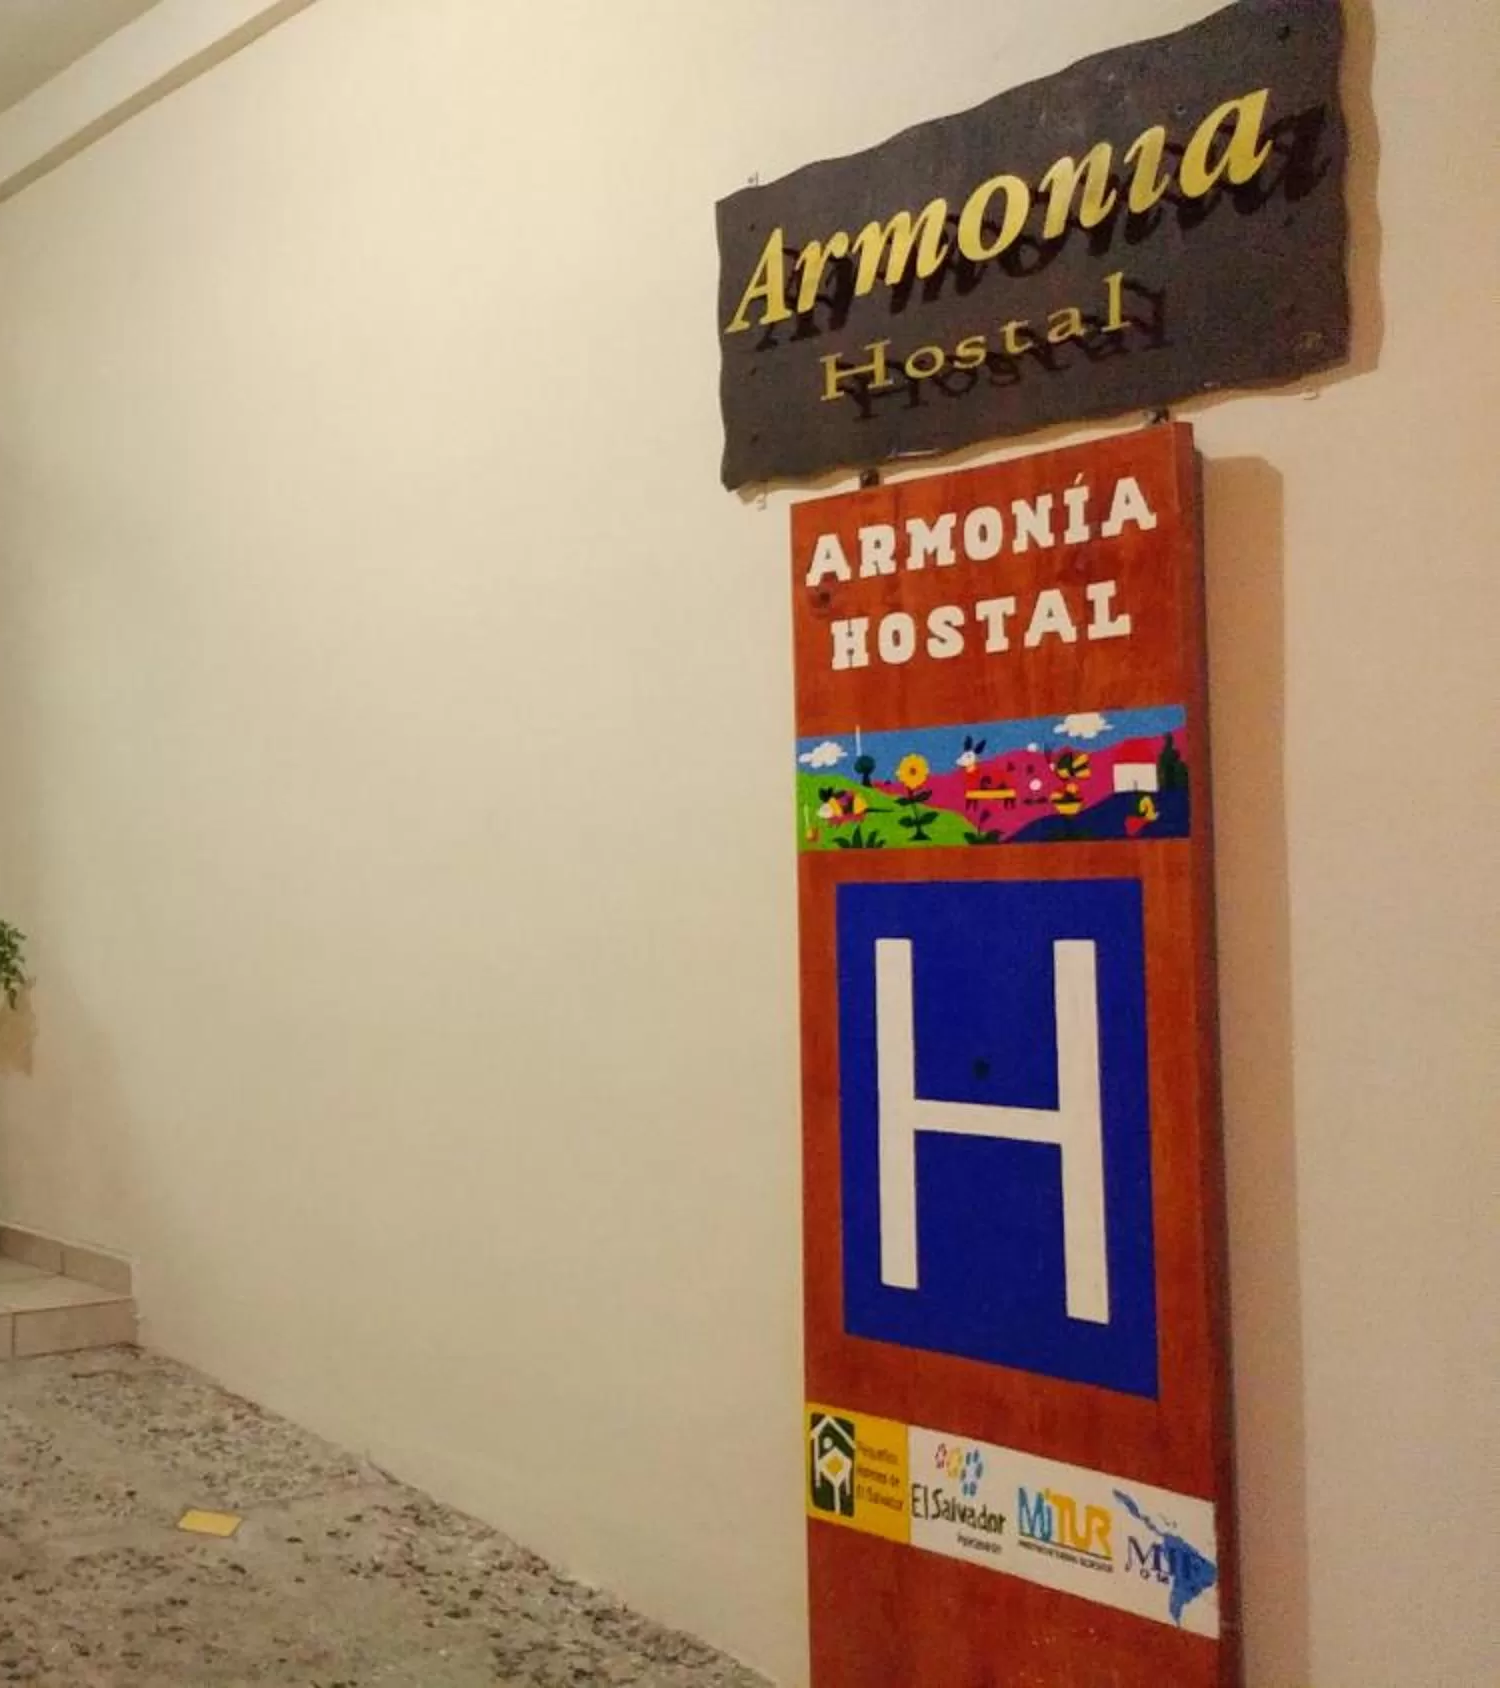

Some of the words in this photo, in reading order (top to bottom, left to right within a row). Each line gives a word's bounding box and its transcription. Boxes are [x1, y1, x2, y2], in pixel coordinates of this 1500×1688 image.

[724, 87, 1273, 334] Armonia
[819, 271, 1133, 401] Hostal
[805, 472, 1157, 587] ARMONÍA
[830, 580, 1133, 671] HOSTAL
[874, 937, 1110, 1325] H
[911, 1482, 929, 1521] El
[931, 1487, 1007, 1535] Salvador
